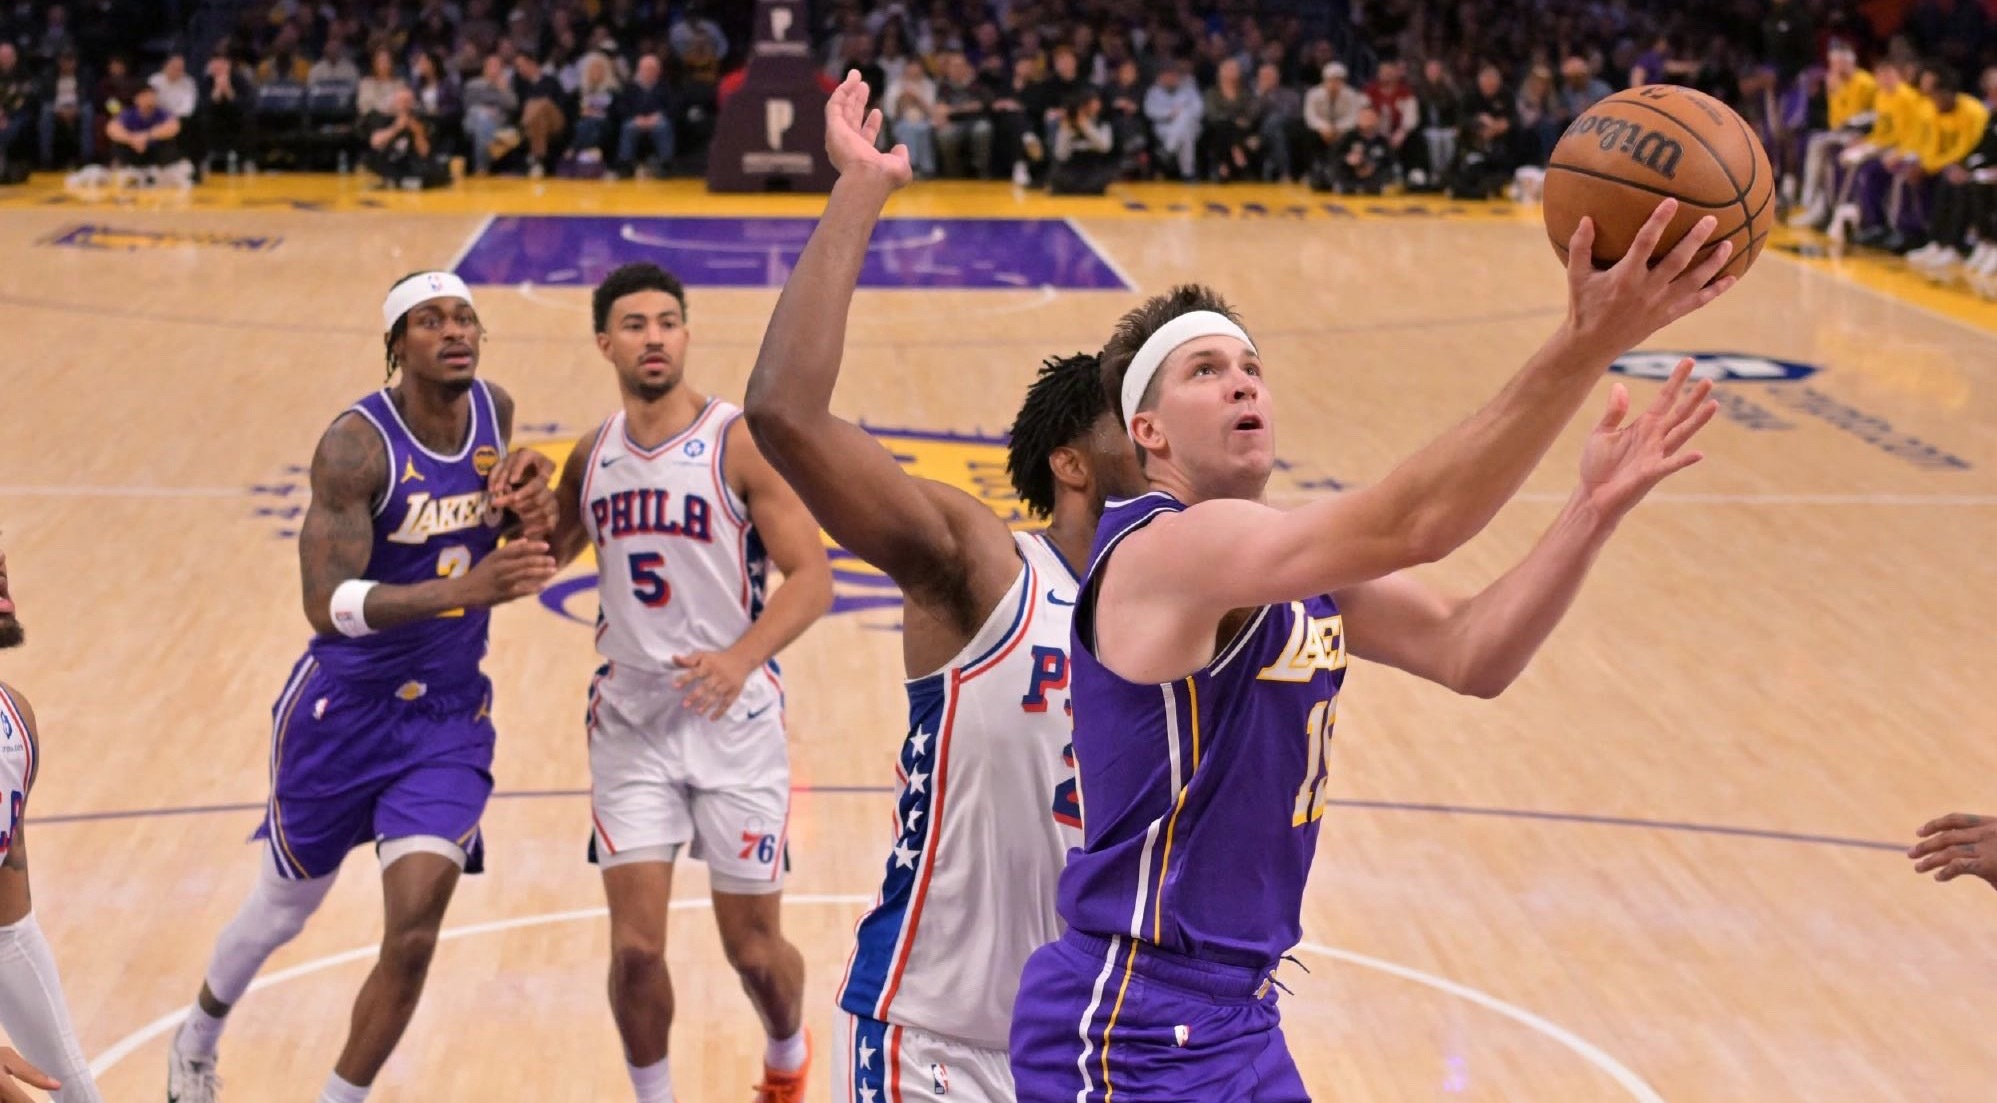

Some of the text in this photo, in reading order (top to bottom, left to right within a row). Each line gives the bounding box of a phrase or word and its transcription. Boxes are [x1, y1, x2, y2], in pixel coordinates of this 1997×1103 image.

[591, 488, 714, 546] PHILA
[628, 552, 671, 608] 5
[738, 830, 775, 864] 76
